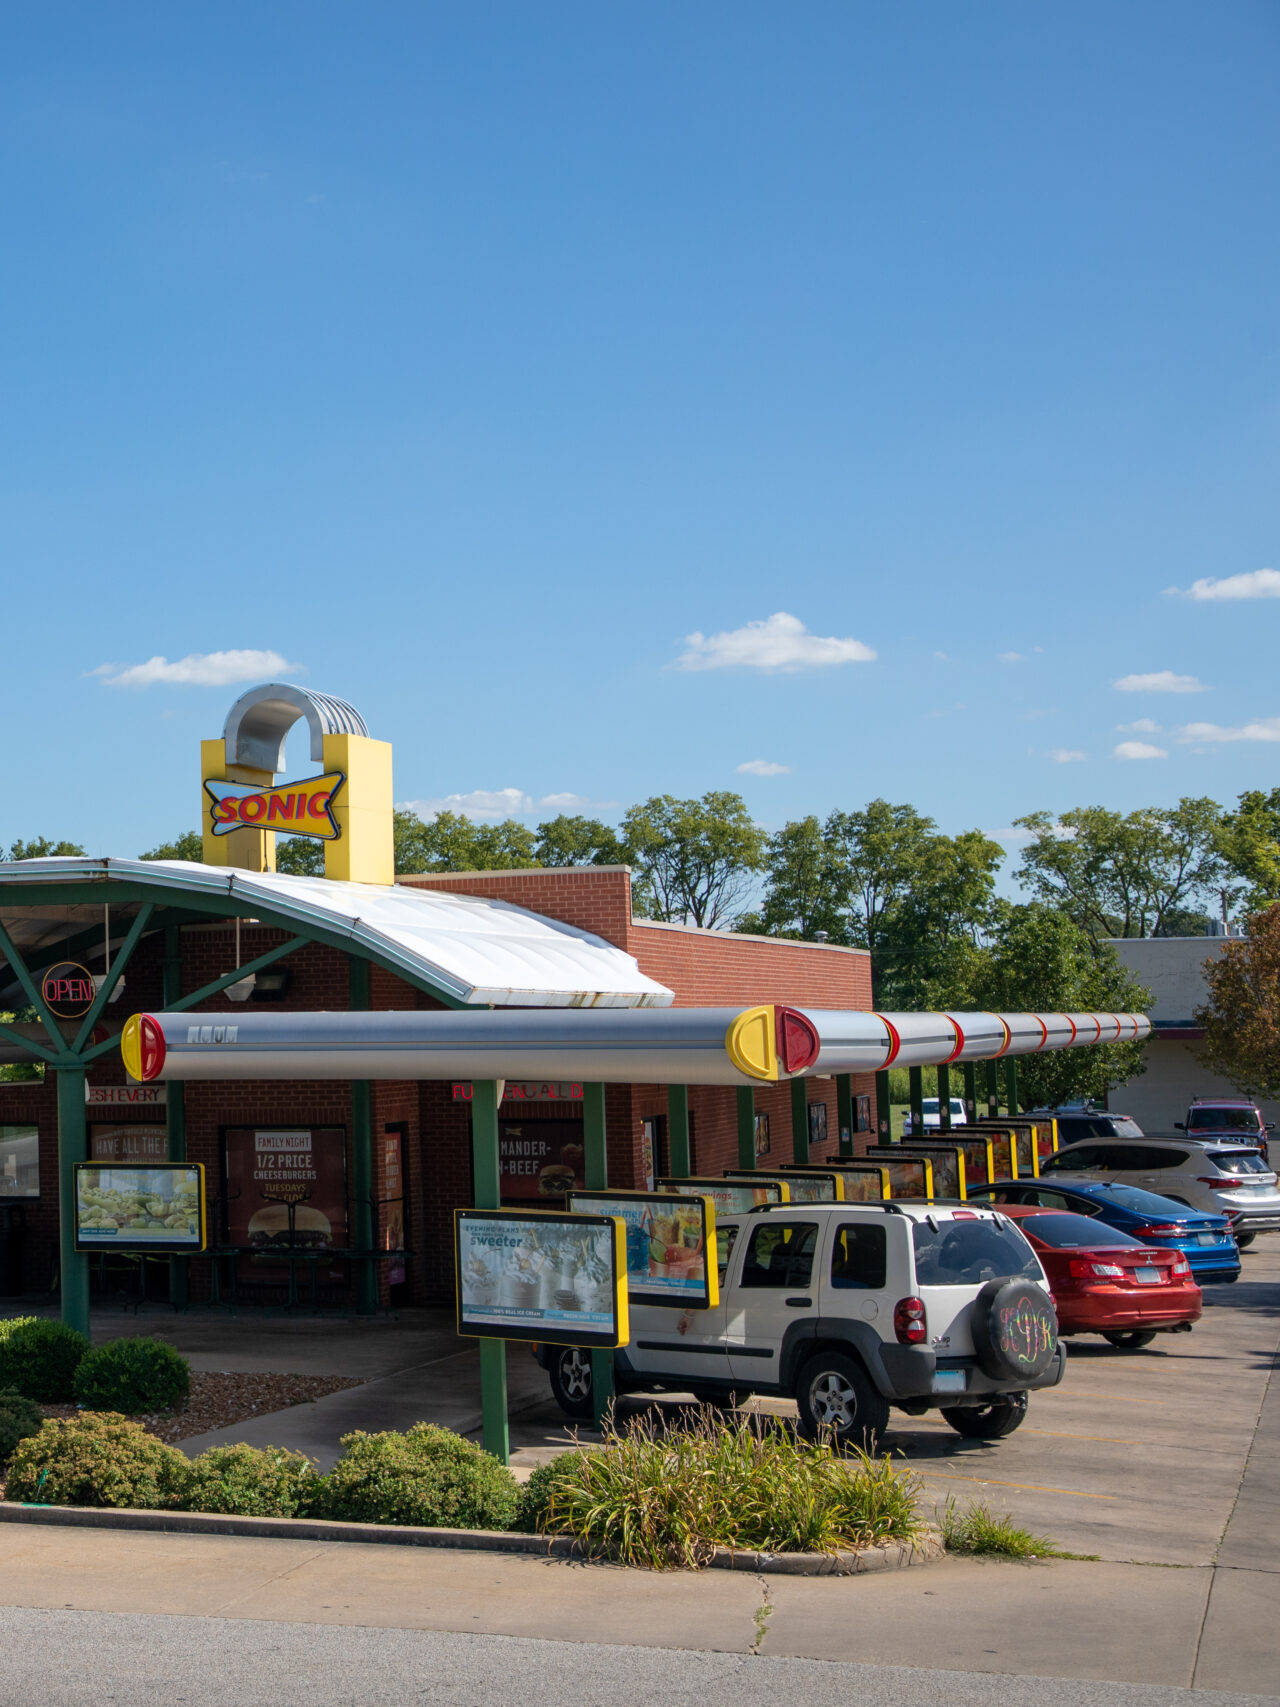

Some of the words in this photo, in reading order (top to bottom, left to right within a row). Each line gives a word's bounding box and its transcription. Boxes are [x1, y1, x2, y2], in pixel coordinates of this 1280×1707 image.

[217, 791, 330, 824] SONIC
[44, 979, 92, 1002] OPEN
[118, 1088, 160, 1102] EVERY
[504, 1084, 536, 1099] ENU
[539, 1084, 567, 1099] ALL
[96, 1138, 120, 1154] HAVE
[122, 1137, 140, 1154] ALL
[142, 1136, 161, 1154] THE
[258, 1137, 284, 1148] FAMILY
[286, 1137, 310, 1148] NIGHT
[257, 1154, 275, 1168] 1/2
[278, 1154, 313, 1168] PRICE
[253, 1170, 317, 1180] CHEESEBURGERS
[265, 1183, 307, 1192] TUESDAYS
[470, 1235, 523, 1247] sweeter
